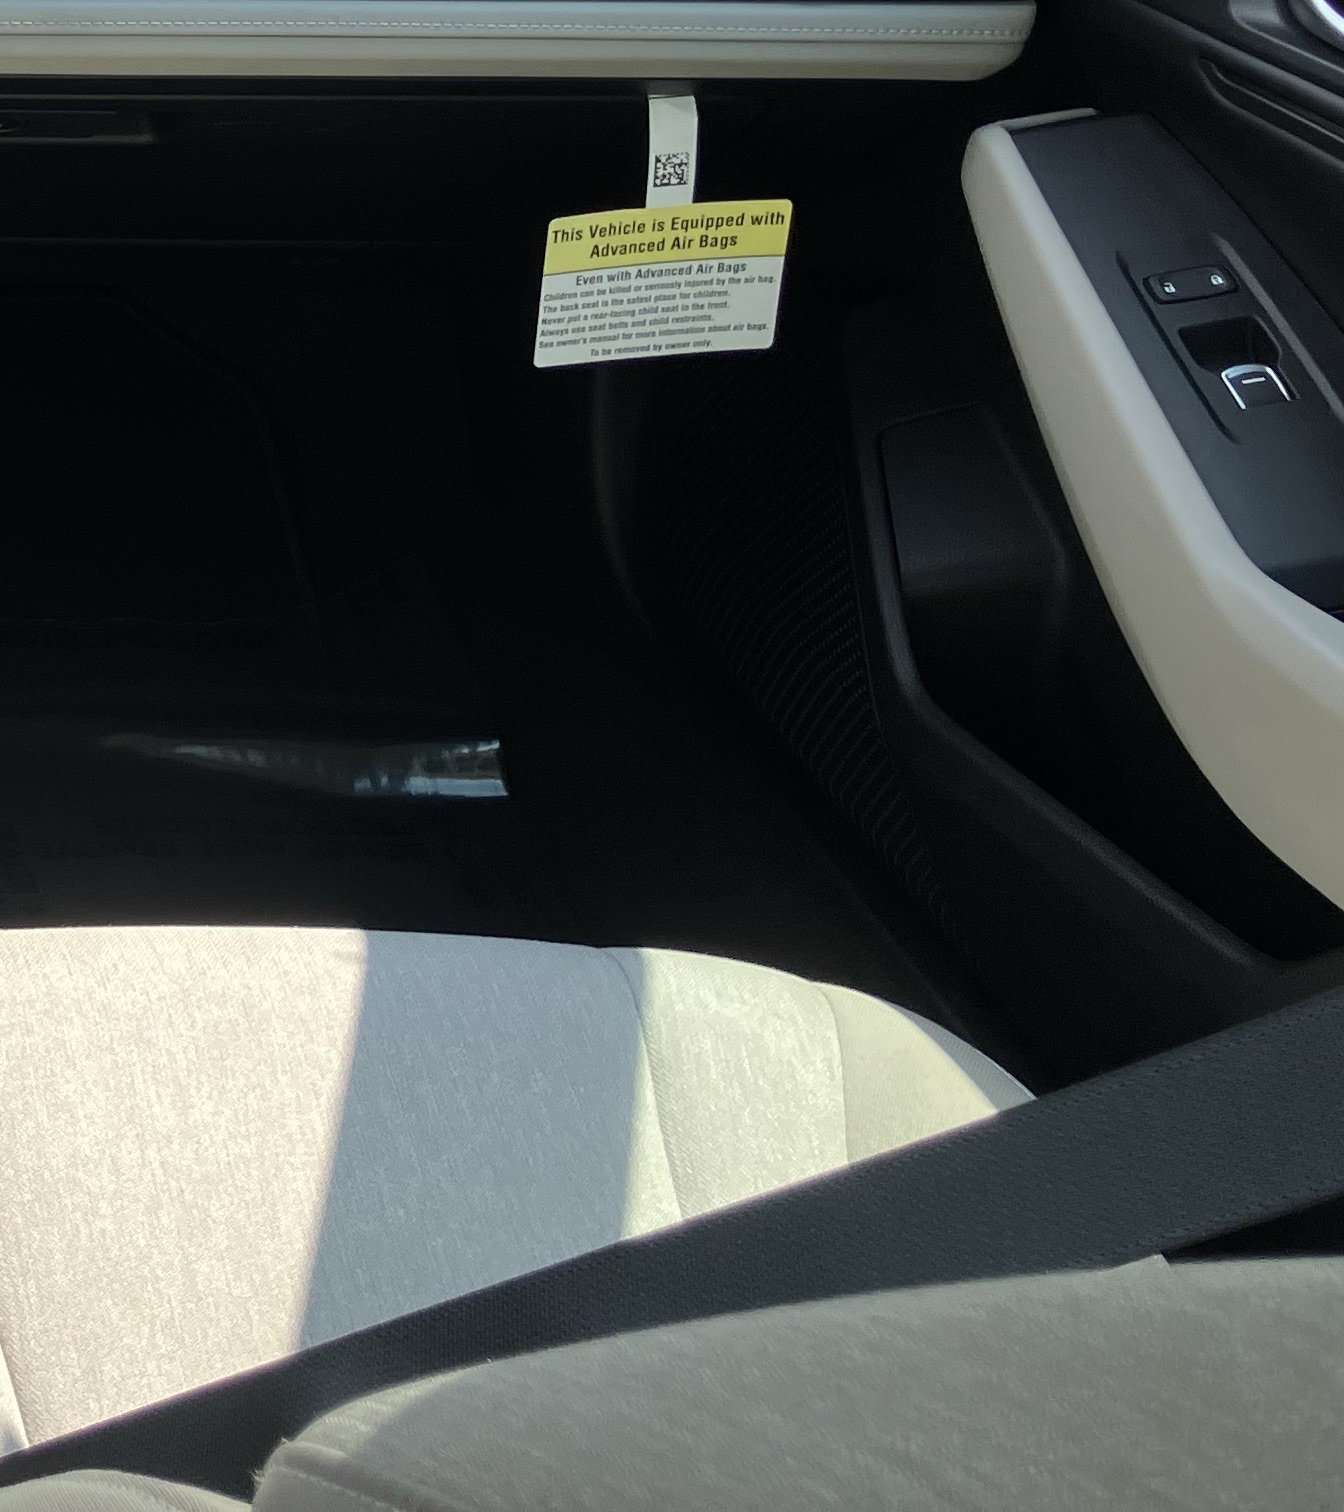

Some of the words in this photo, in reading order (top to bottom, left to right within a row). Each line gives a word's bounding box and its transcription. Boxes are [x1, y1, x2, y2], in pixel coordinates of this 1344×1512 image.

[552, 227, 583, 244] This
[589, 220, 646, 239] Vehicle
[652, 219, 665, 232] is
[671, 213, 745, 233] Equipped
[751, 211, 785, 226] with
[590, 237, 666, 259] Advanced
[671, 236, 694, 250] Air
[699, 235, 738, 250] Bags
[575, 275, 603, 286] Even
[607, 270, 631, 283] with
[635, 265, 692, 280] Advanced
[696, 263, 714, 275] Air
[716, 262, 747, 274] Bags
